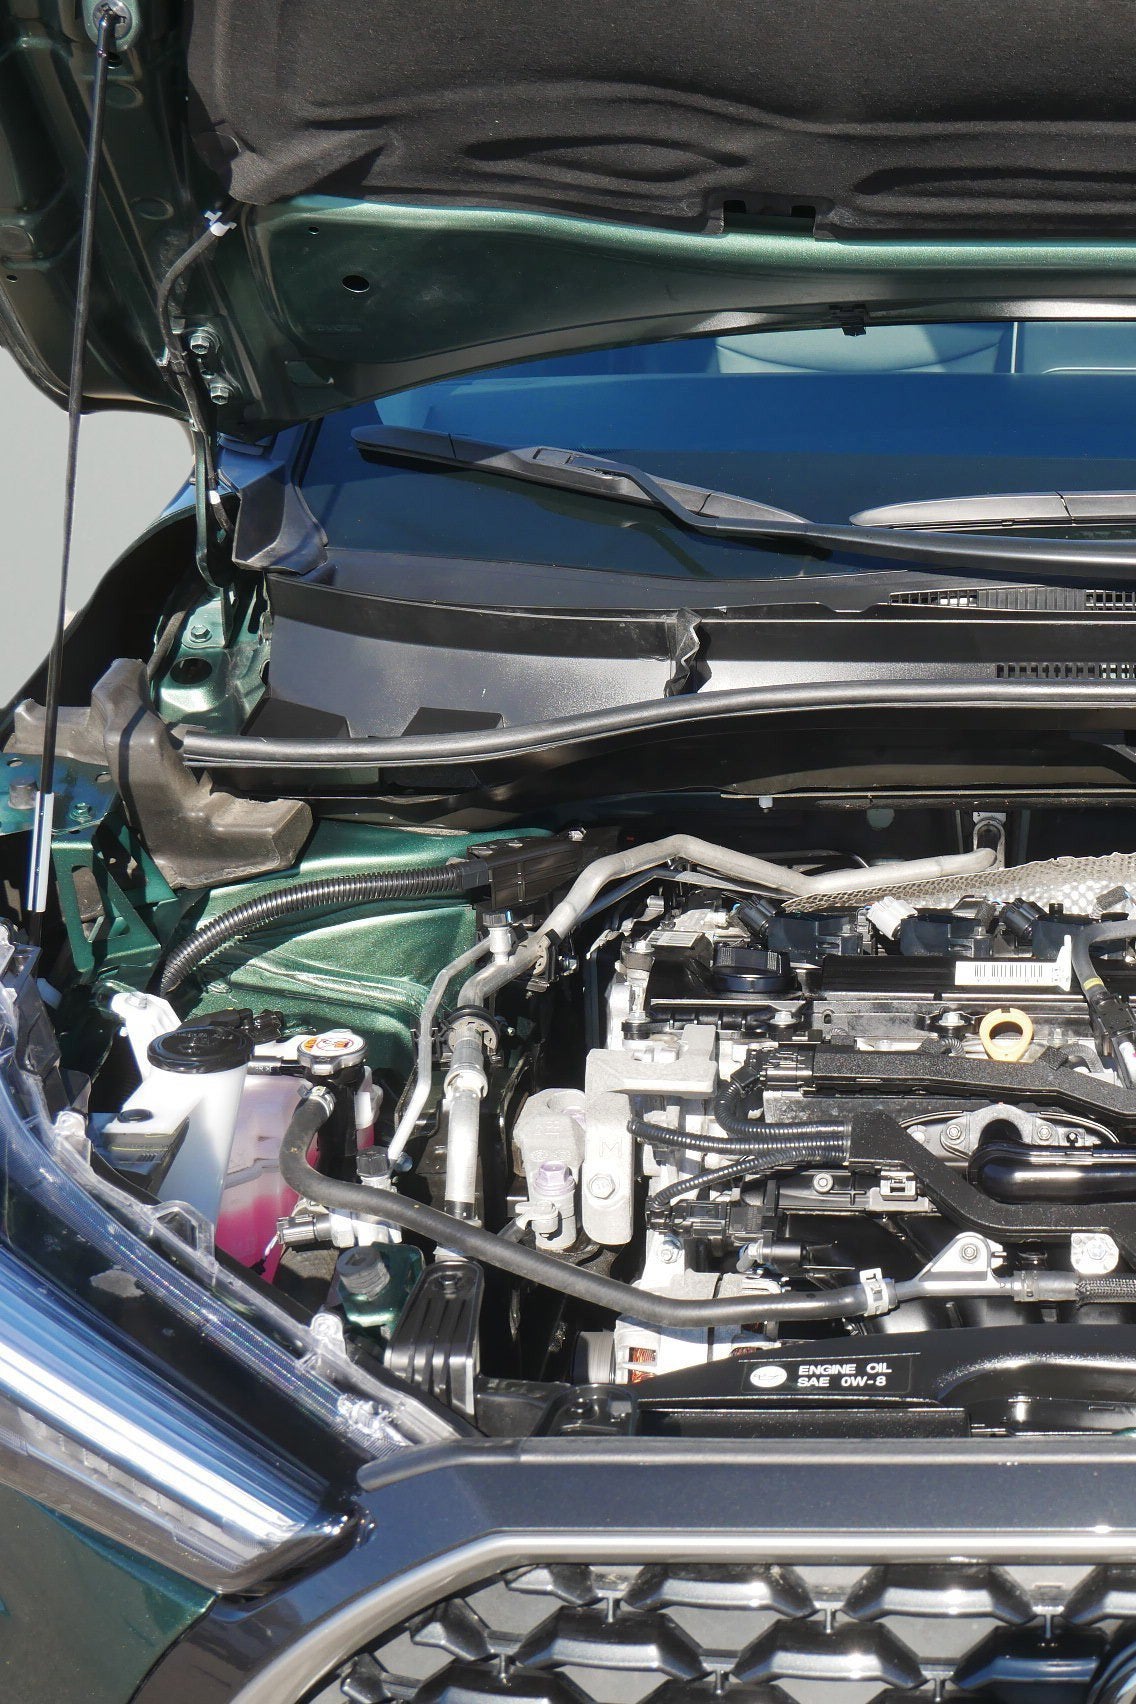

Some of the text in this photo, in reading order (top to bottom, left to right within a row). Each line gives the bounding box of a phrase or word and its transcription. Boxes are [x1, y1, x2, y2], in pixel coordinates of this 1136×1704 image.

[798, 1362, 892, 1375] ENGINE OIL
[797, 1375, 887, 1387] SAE 0W-8
